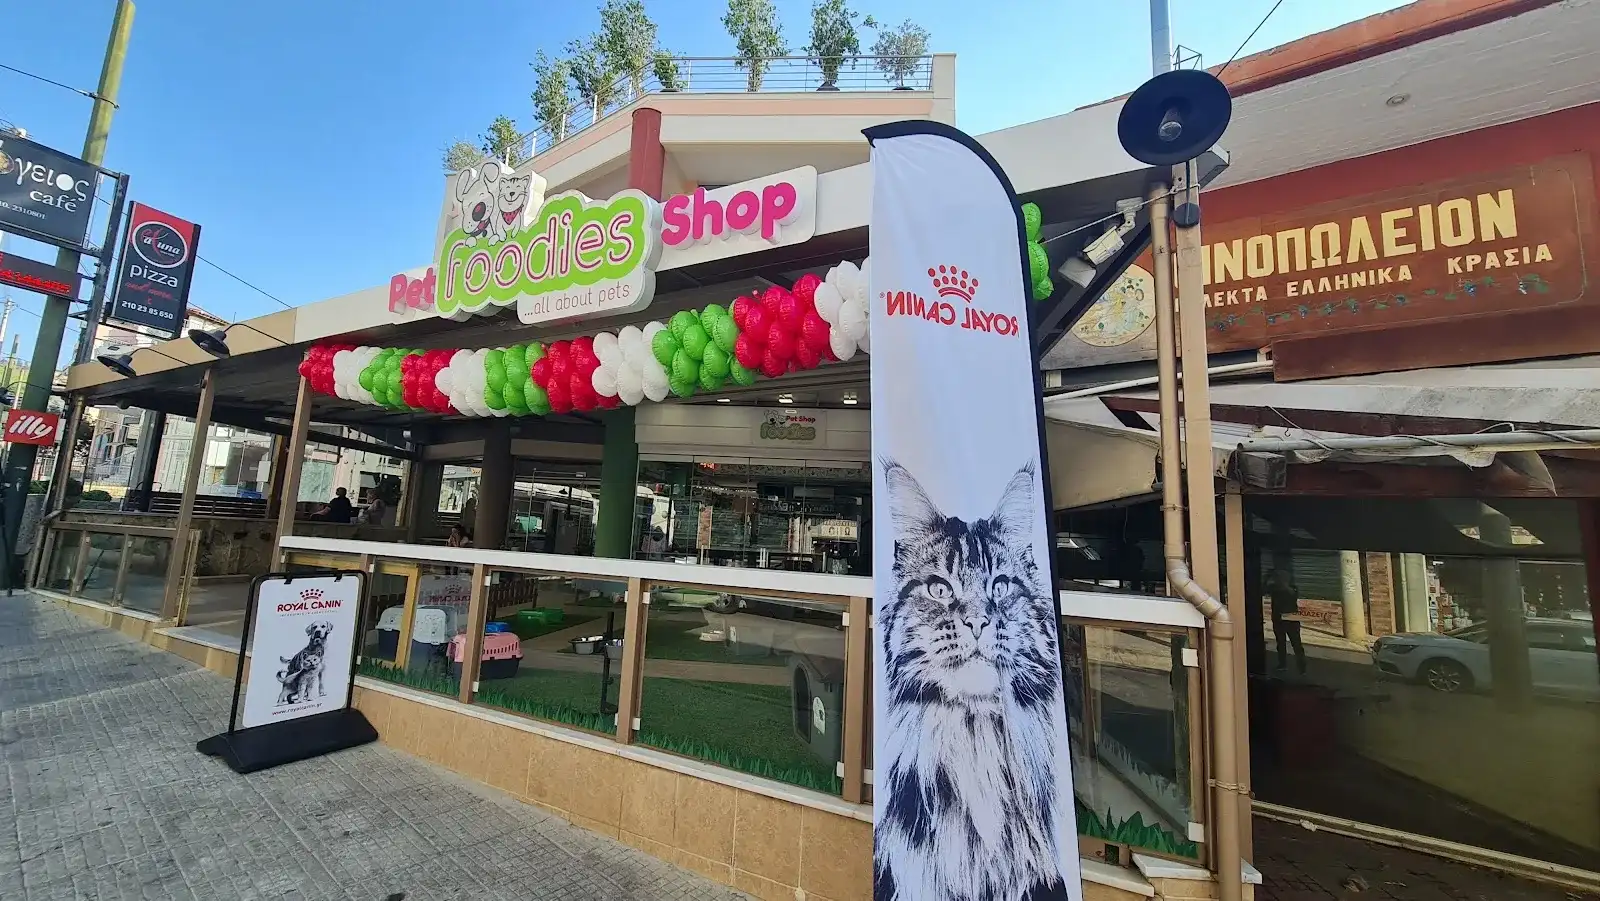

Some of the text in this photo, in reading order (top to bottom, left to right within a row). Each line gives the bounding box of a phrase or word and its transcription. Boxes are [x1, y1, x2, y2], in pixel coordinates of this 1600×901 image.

[29, 189, 77, 213] café
[389, 181, 798, 313] Pet foodies Shop
[1173, 189, 1519, 289] ΙΝΟΠΩΛΕΙΟΝ
[129, 264, 178, 288] pizza
[1286, 264, 1413, 298] ΕΛΛΗΝΙΚΑ
[1446, 243, 1554, 275] ΚΡΑΣΙΑ
[555, 287, 593, 312] about
[598, 281, 631, 308] pets
[121, 300, 137, 310] 210
[136, 304, 148, 313] 23
[158, 310, 174, 320] 650
[9, 415, 54, 440] illy
[798, 416, 816, 424] Shop
[277, 599, 342, 613] ROYAL CANIN
